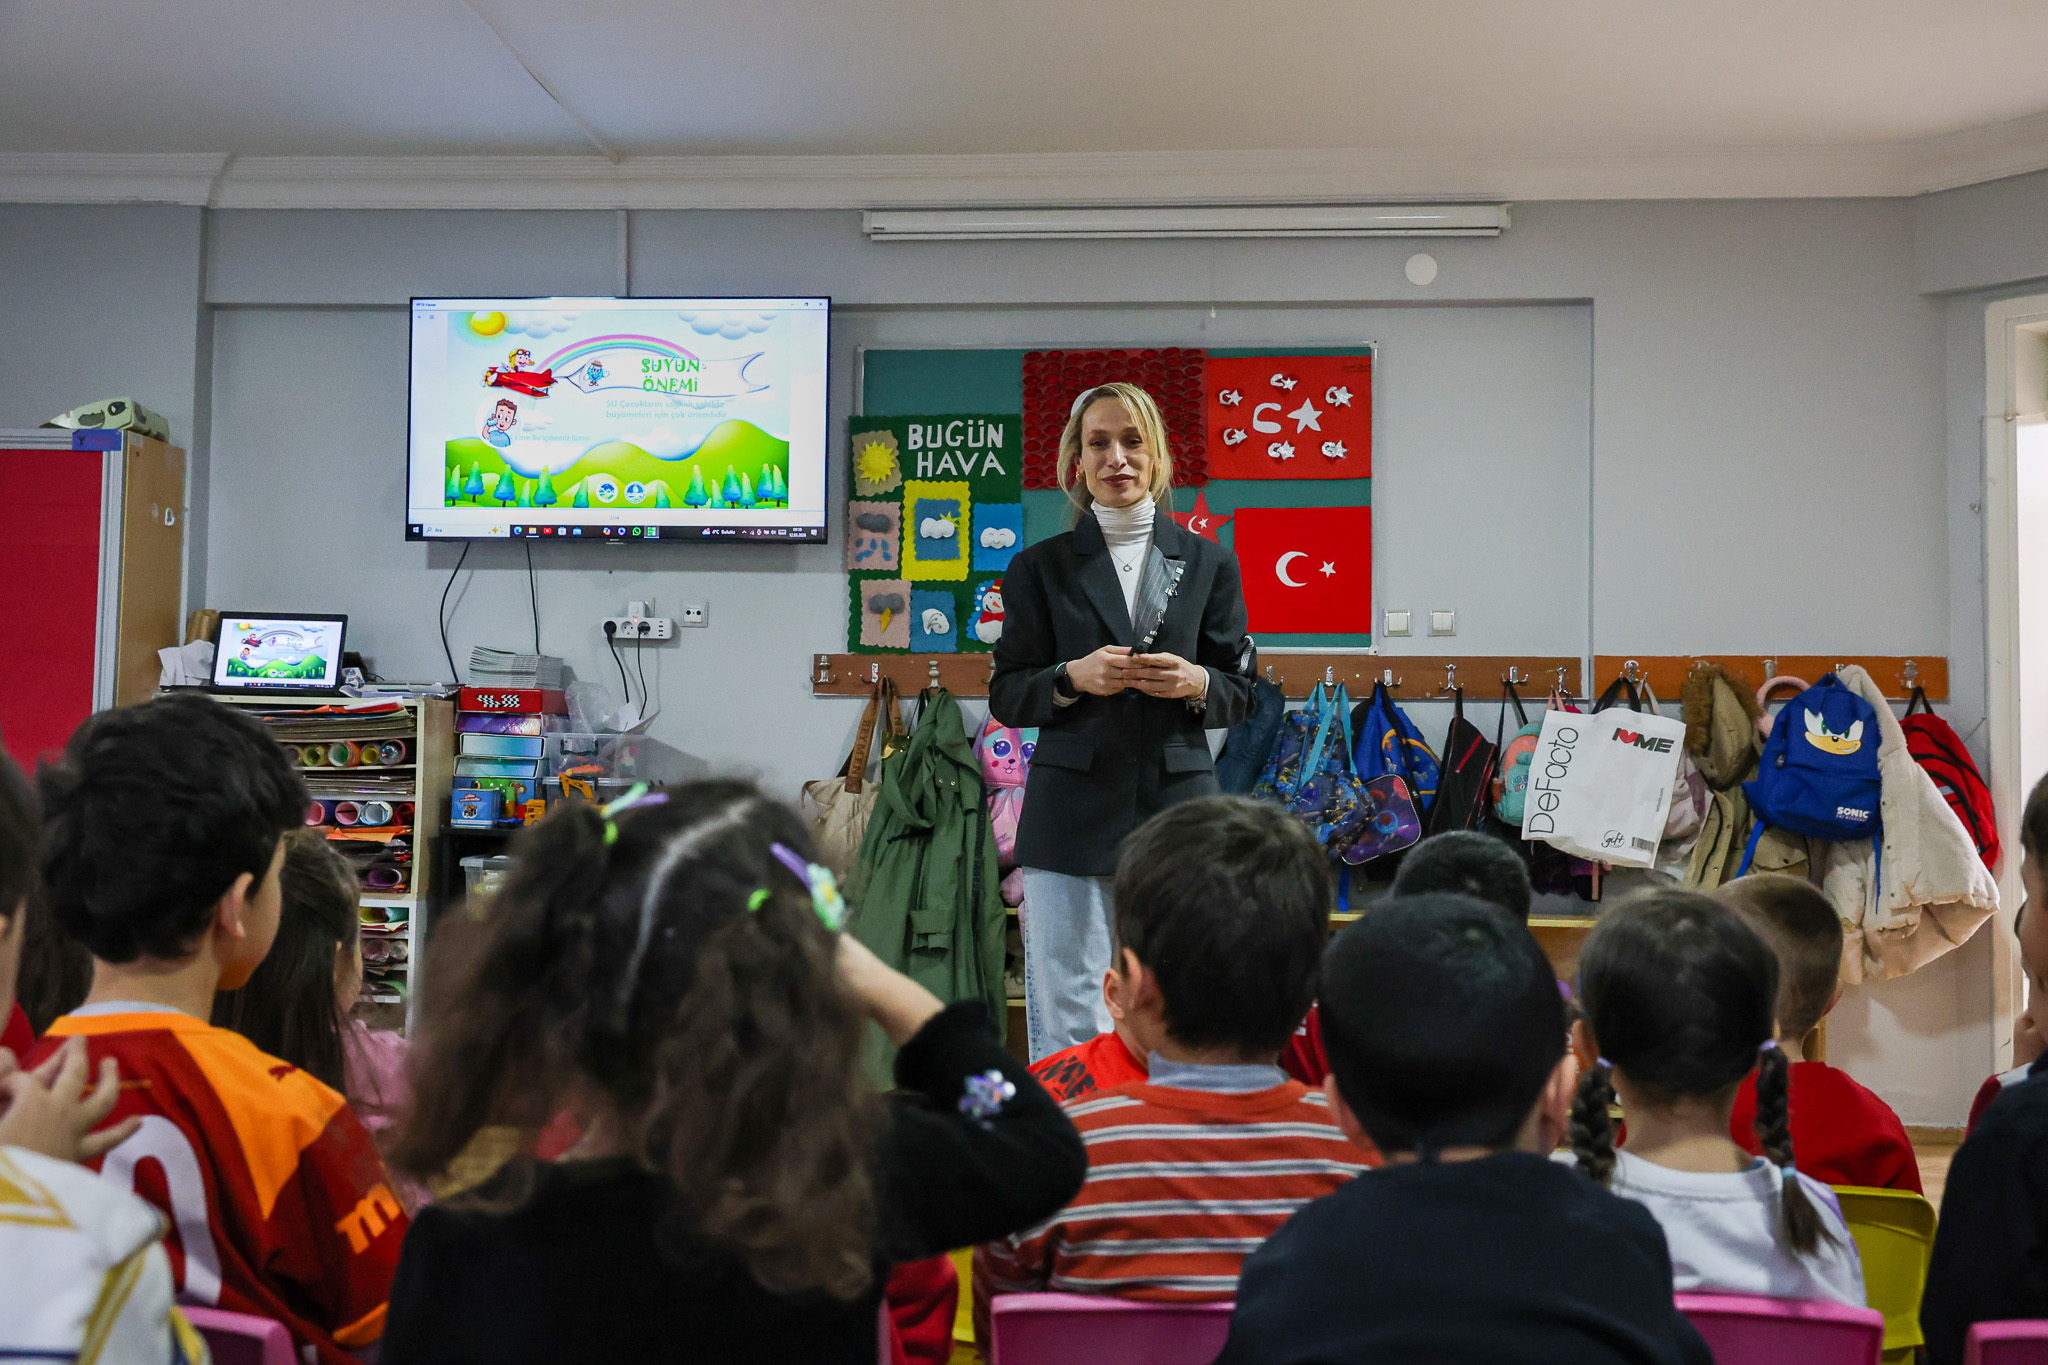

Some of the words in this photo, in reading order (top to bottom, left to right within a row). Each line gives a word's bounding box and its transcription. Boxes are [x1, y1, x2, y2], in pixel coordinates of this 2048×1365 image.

[641, 357, 700, 373] SUYUN
[908, 419, 1004, 450] BUGÜN
[916, 450, 1006, 477] HAVA
[1633, 733, 1675, 754] ME
[1528, 727, 1579, 834] DeFacto
[1836, 806, 1870, 819] SONIC
